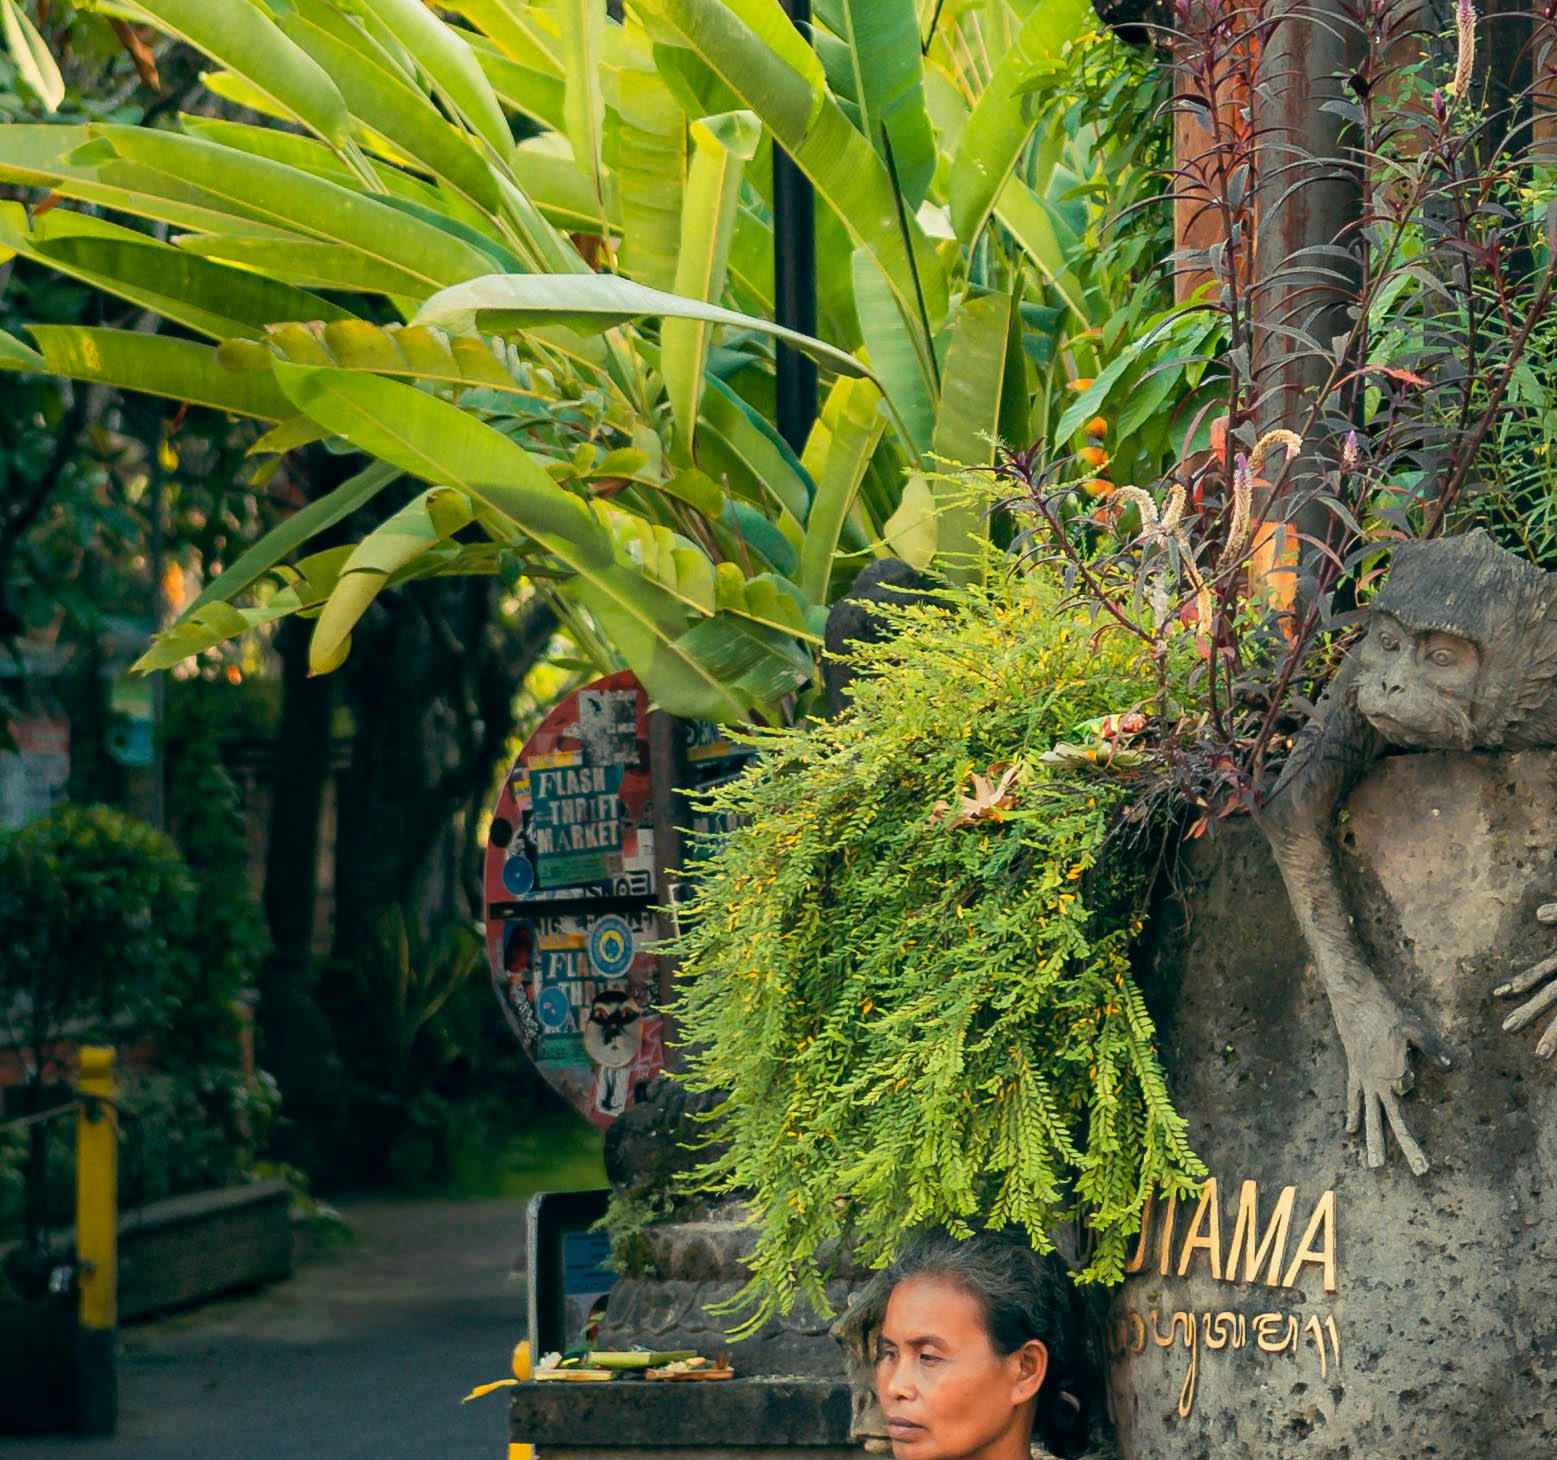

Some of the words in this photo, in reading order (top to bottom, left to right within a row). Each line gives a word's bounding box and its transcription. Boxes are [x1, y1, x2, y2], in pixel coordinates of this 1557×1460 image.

[538, 767, 606, 798] FLASH
[549, 793, 620, 825] THRIFT
[537, 820, 620, 854] MARKET
